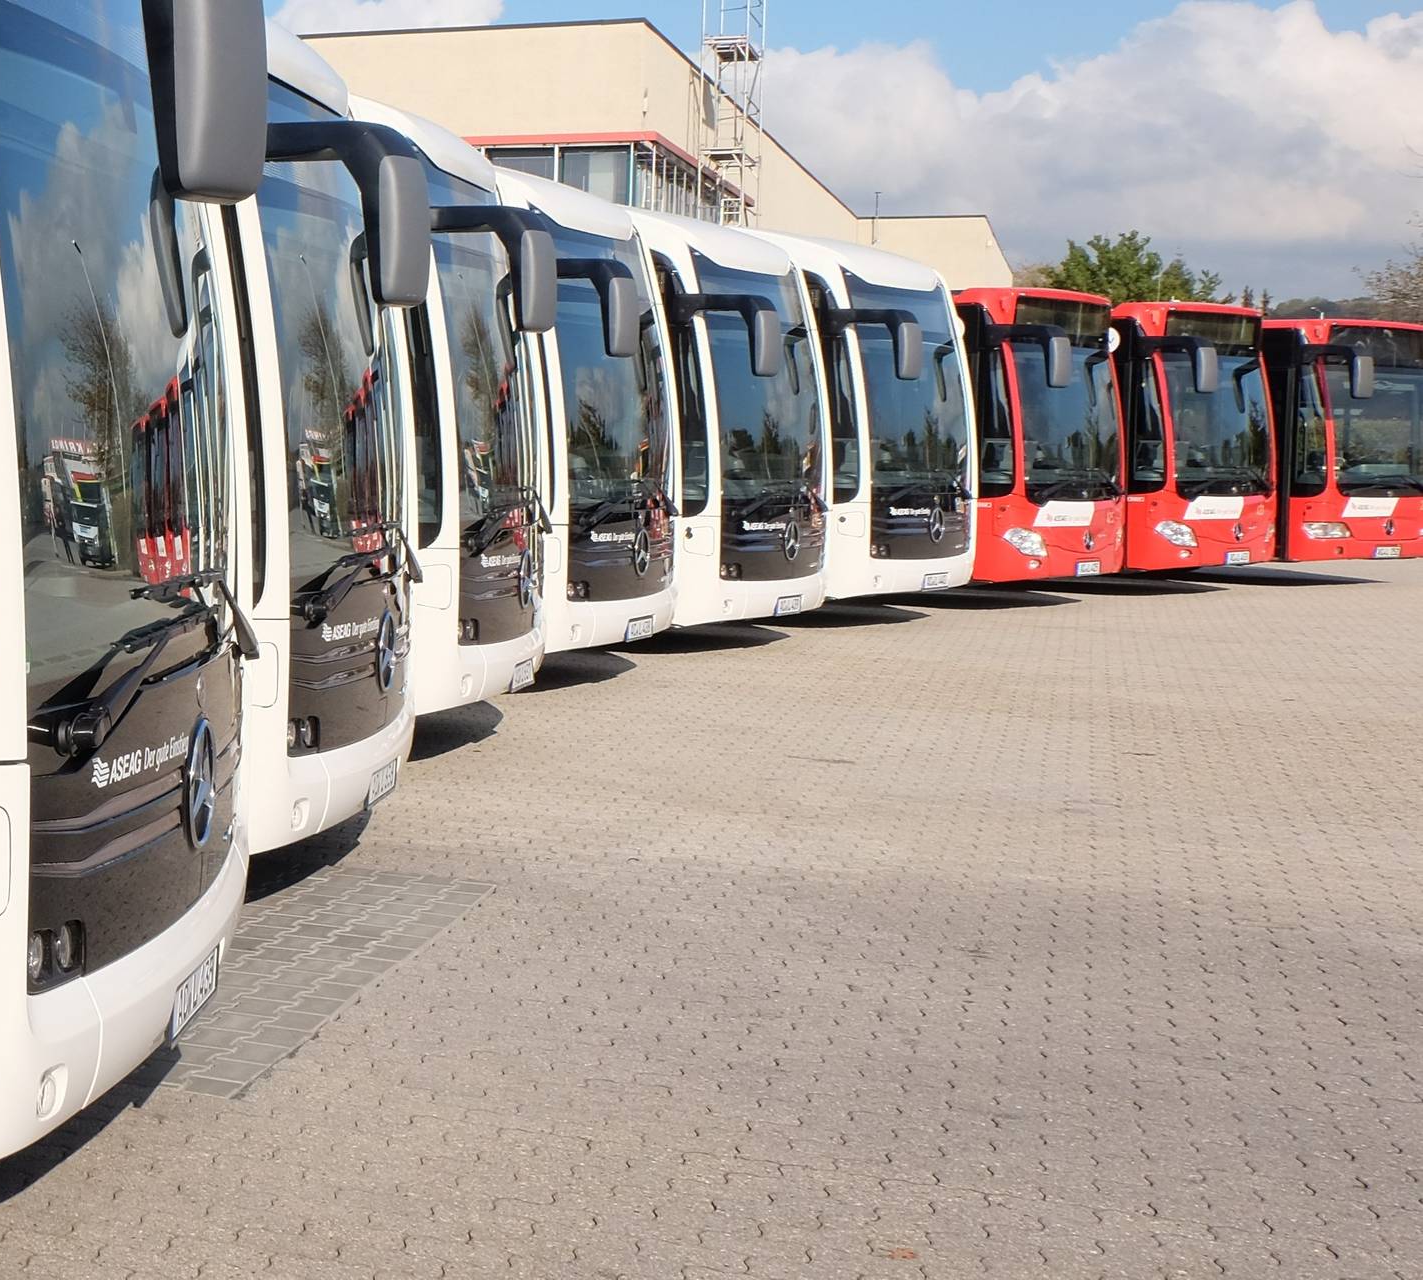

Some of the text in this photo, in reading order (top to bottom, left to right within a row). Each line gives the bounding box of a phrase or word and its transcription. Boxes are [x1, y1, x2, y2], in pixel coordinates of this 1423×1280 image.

[109, 749, 142, 784] ASEAG
[143, 747, 156, 770] Der
[156, 741, 169, 772] gute
